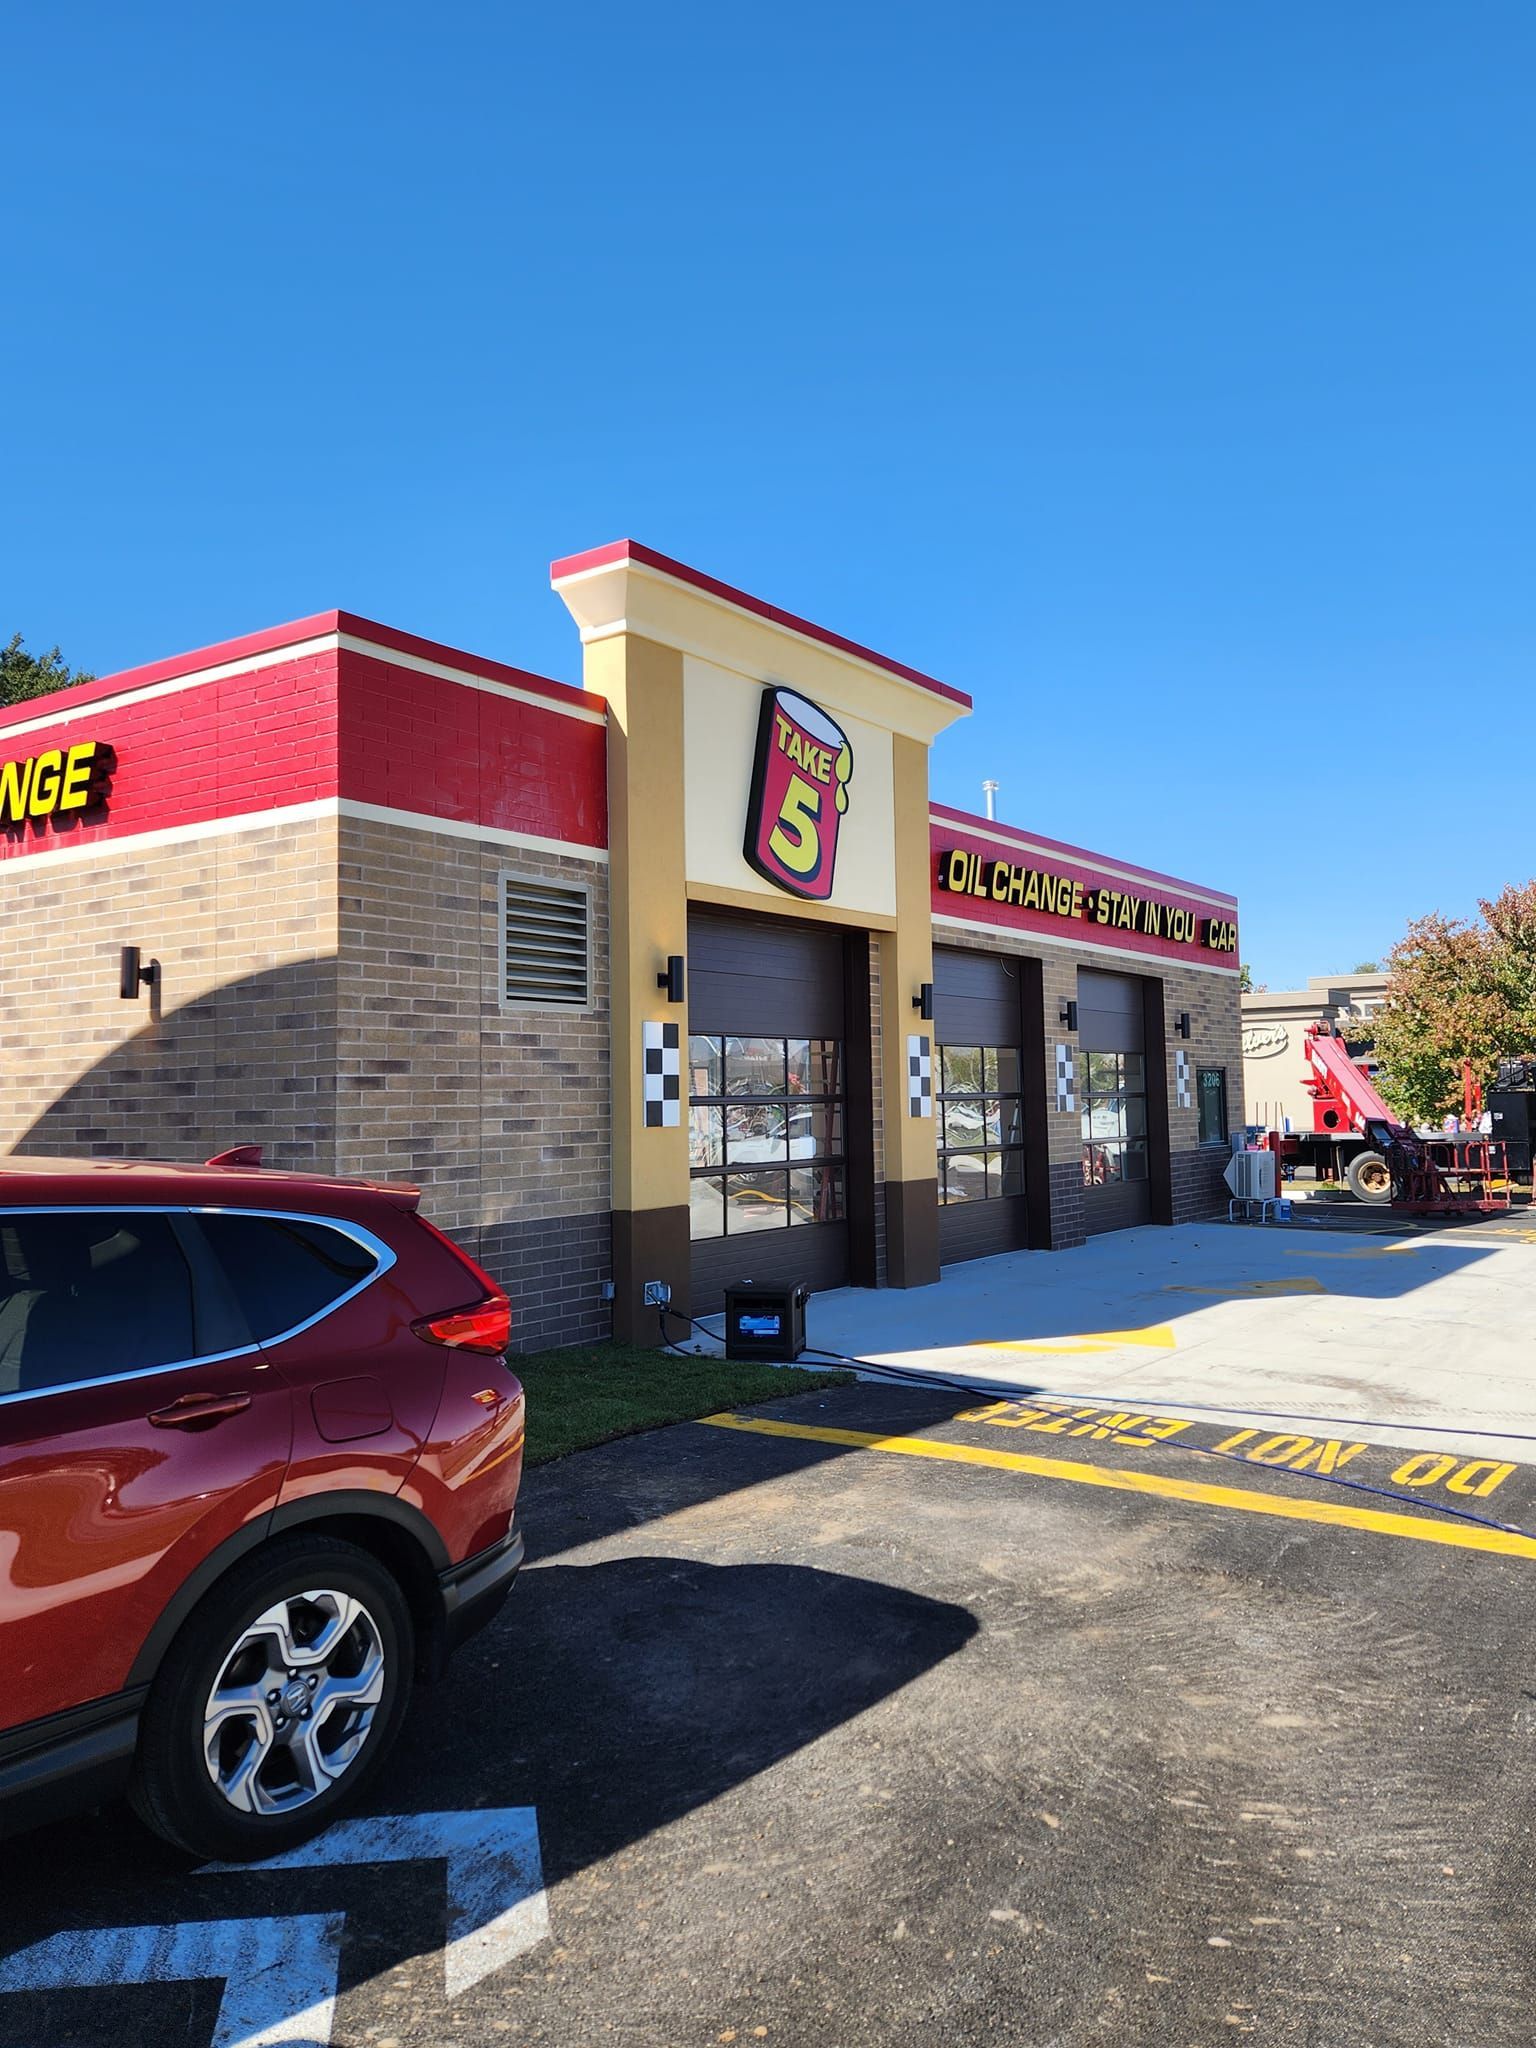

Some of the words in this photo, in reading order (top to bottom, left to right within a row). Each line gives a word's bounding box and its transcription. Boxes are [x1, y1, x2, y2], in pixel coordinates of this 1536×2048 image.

[0, 741, 96, 821] NGE
[775, 714, 833, 784] TAKE
[768, 773, 822, 875] 5
[948, 849, 987, 898] OIL
[992, 861, 1085, 919] CHANGE
[1096, 888, 1140, 930] STAY
[1143, 900, 1161, 937] IN
[1165, 905, 1196, 944] YOU
[1208, 918, 1237, 953] CAR
[1202, 1072, 1221, 1088] 3206
[1193, 1429, 1369, 1475] NOT
[1390, 1453, 1518, 1497] DO
